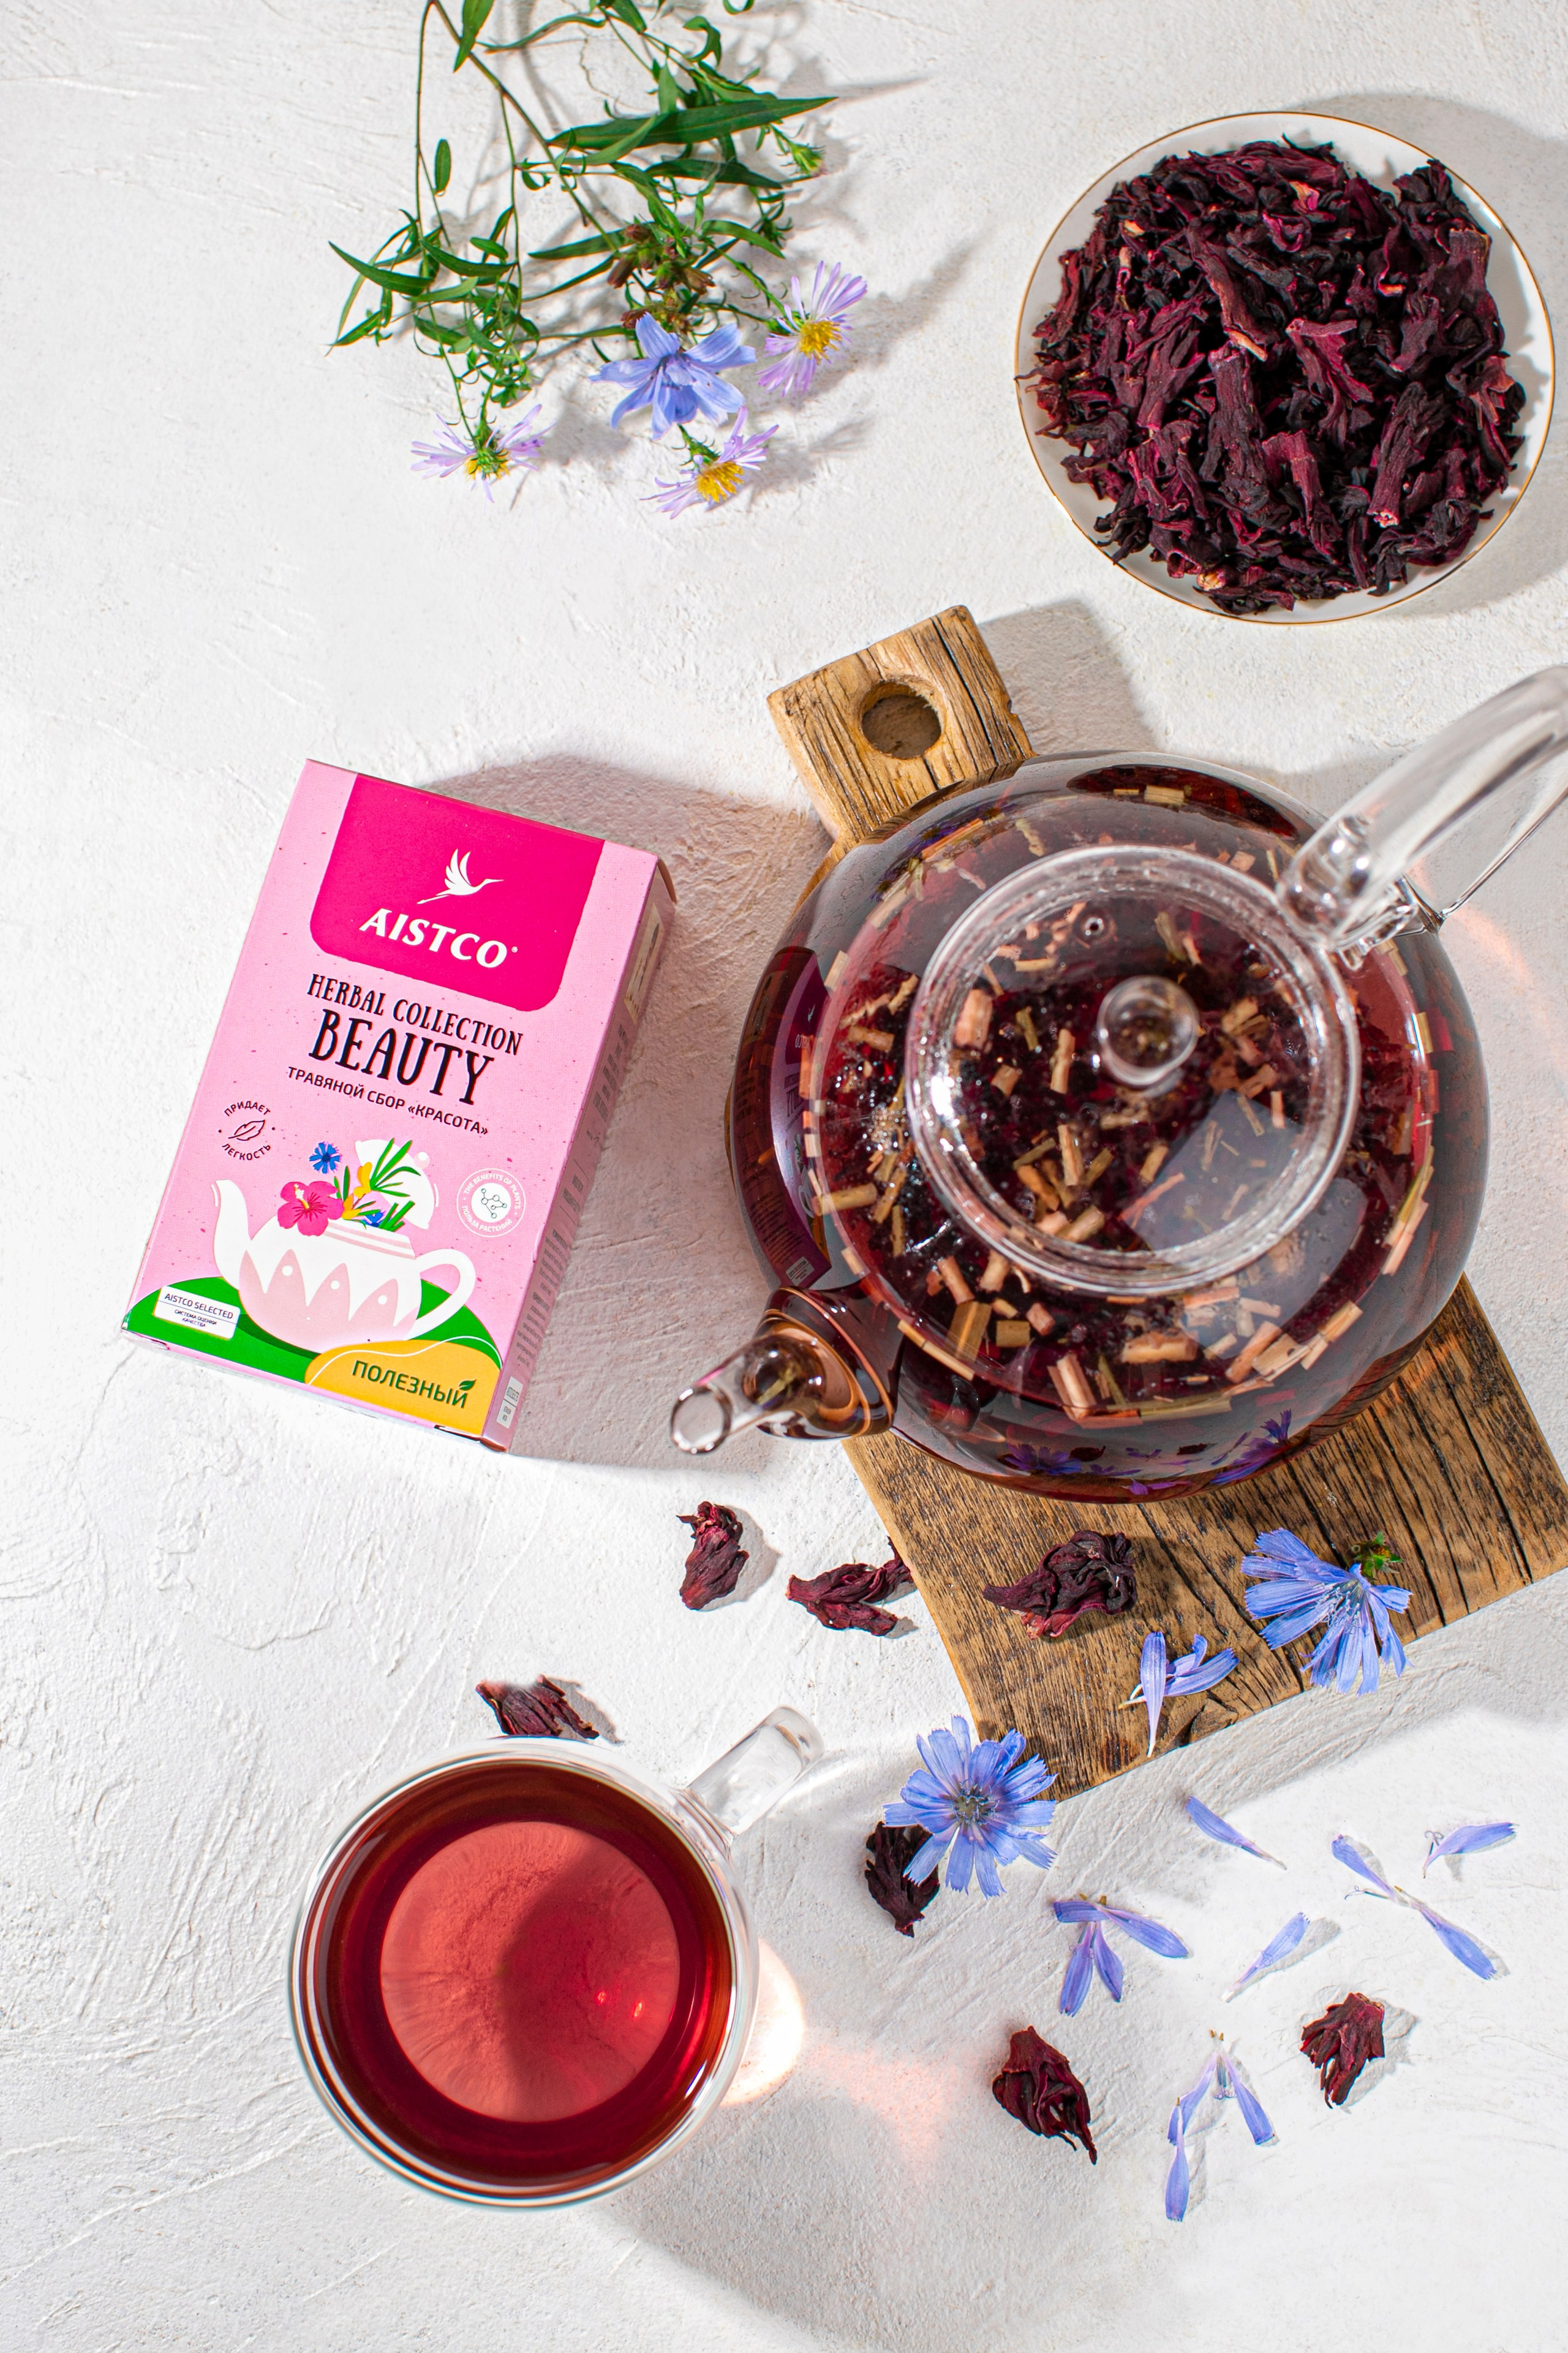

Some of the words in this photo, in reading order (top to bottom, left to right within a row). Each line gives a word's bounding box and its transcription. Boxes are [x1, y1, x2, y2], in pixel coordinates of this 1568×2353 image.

[306, 973, 386, 1016] HERBAL
[393, 998, 524, 1056] COLLECTION
[307, 1008, 495, 1106] BEAUTY
[224, 1100, 271, 1117] ПРИДАЕТ
[287, 1065, 364, 1100] ТРАВЯНОЙ
[367, 1090, 405, 1110] СБОР
[408, 1103, 488, 1136] «КРАСОТА»
[222, 1143, 271, 1160] ЛЕГКОСТЬ
[463, 1182, 475, 1195] THE
[472, 1173, 503, 1184] BENEFITS
[510, 1184, 521, 1210] PLANTS
[462, 1206, 479, 1229] ПОЛЬЗА
[478, 1219, 513, 1233] РАСТЕНИЙ
[164, 1293, 193, 1307] AISTCO
[194, 1301, 234, 1320] SELECTED
[351, 1358, 471, 1409] ПОЛЕЗНЫЙ
